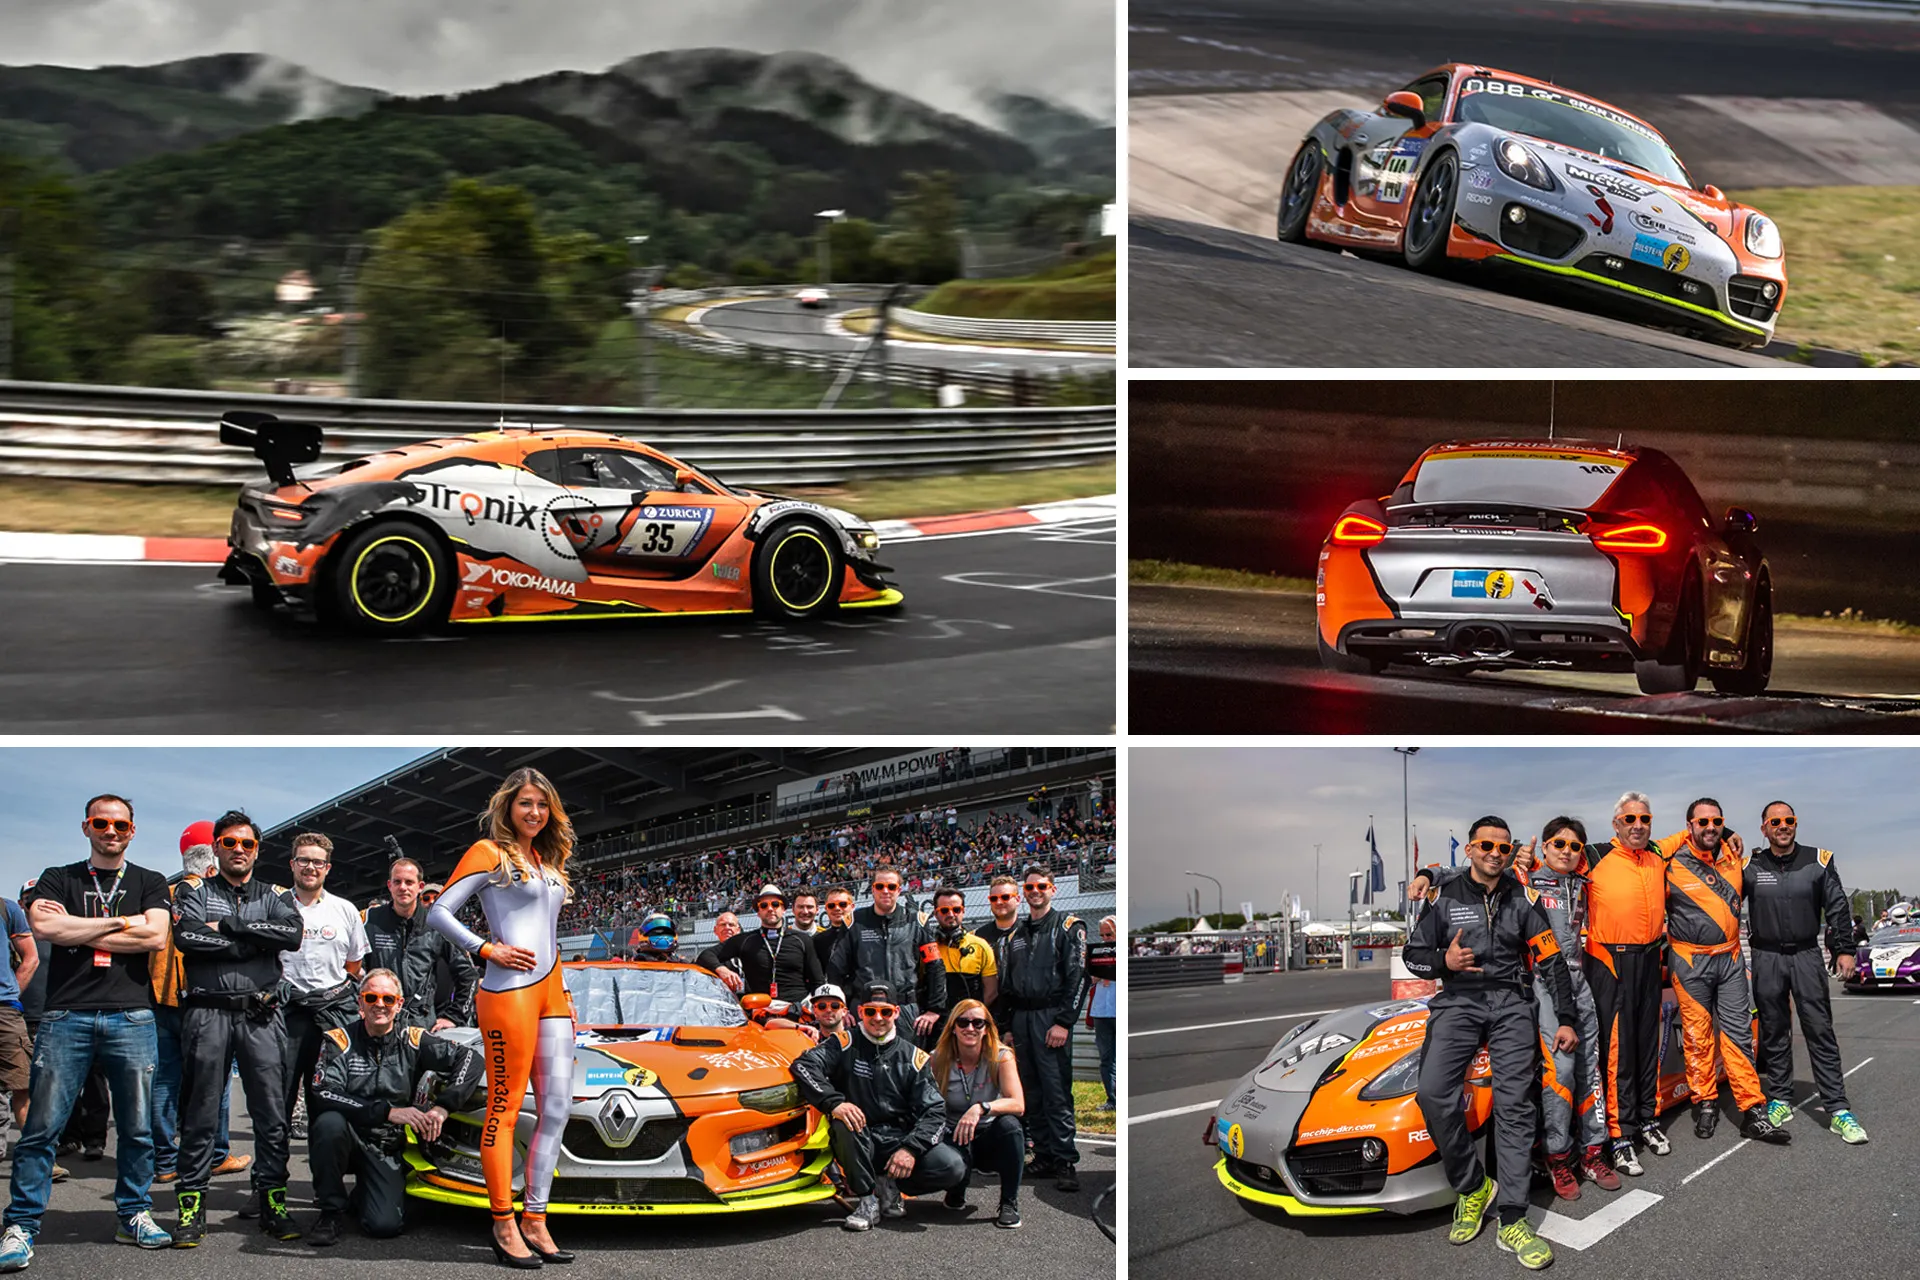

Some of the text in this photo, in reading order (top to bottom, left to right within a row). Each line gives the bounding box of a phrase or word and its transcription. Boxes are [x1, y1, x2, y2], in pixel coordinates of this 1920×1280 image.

[658, 507, 702, 519] ZURICH
[641, 522, 676, 553] 35
[490, 568, 577, 597] YOKOHAMA
[1453, 579, 1484, 589] BILSTEIN
[847, 806, 871, 818] Ausgang
[1376, 1019, 1427, 1037] SUN
[587, 1072, 624, 1080] BILSTEIN
[484, 1029, 510, 1148] gtronix360.com
[1299, 1122, 1377, 1140] mcchip-dkr.com
[1407, 1129, 1432, 1144] RE
[749, 1155, 788, 1170] YOKOHAMA
